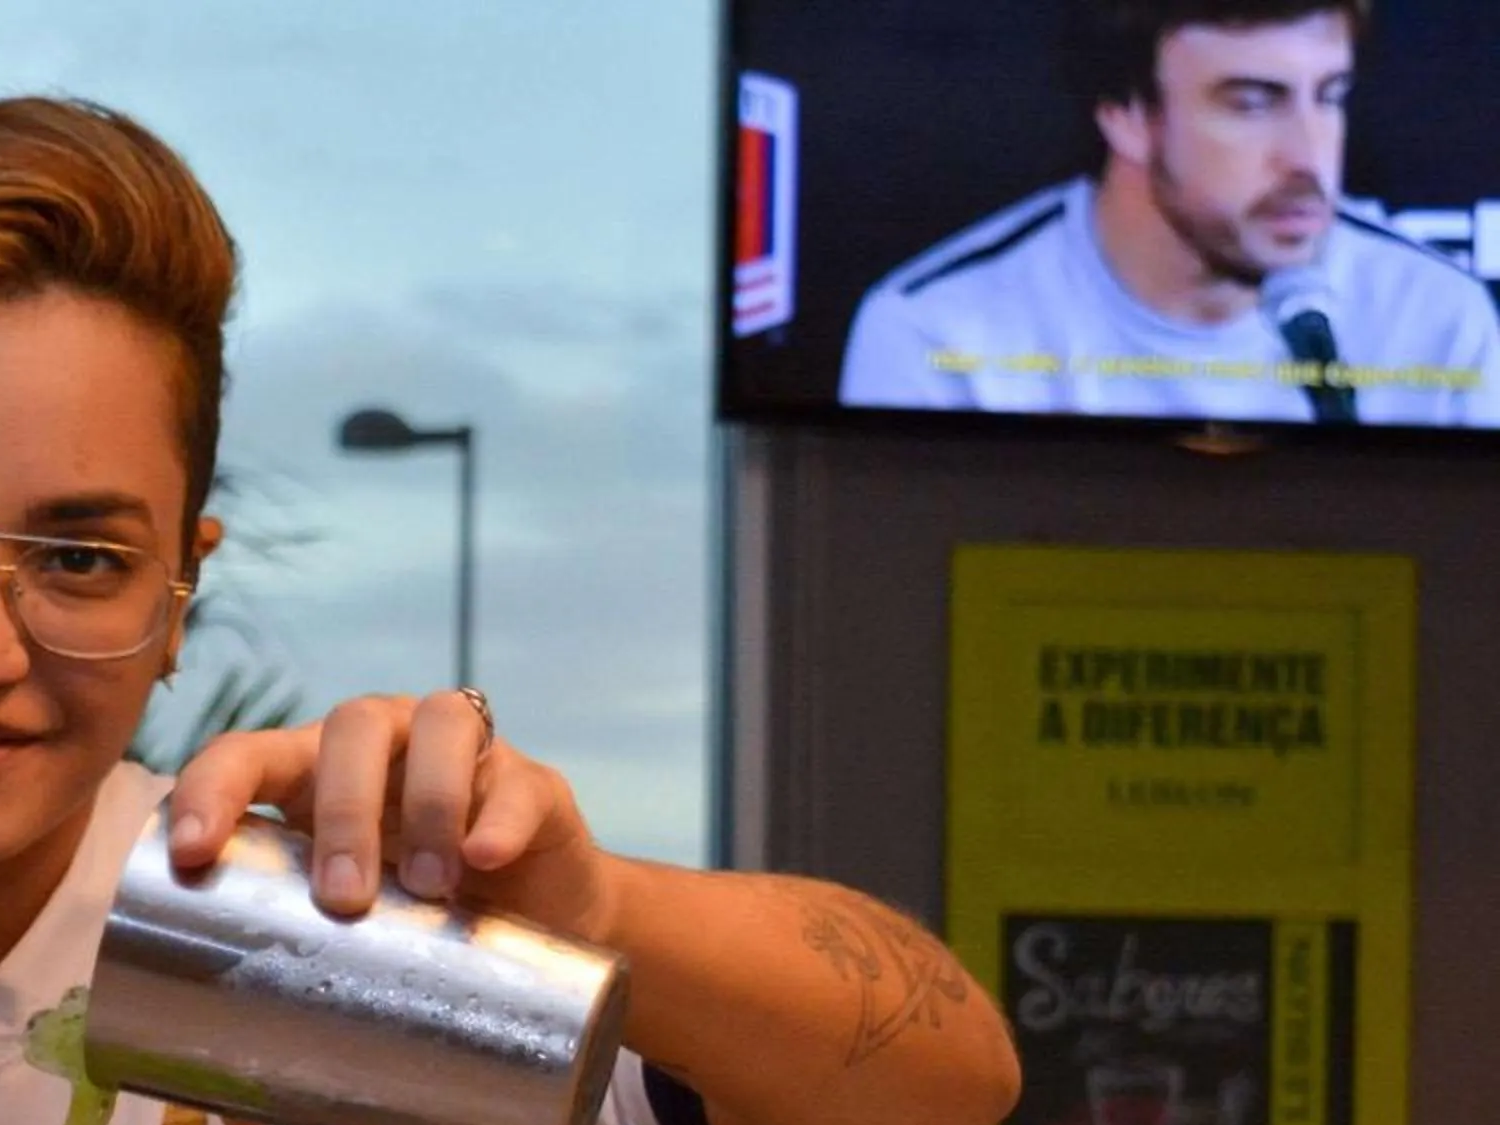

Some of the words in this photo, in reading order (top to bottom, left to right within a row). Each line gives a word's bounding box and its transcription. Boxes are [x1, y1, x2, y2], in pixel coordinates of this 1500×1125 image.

[1039, 646, 1327, 695] EXPERIMENTE
[1037, 699, 1067, 743] A
[1081, 701, 1326, 756] DIFERENÇA
